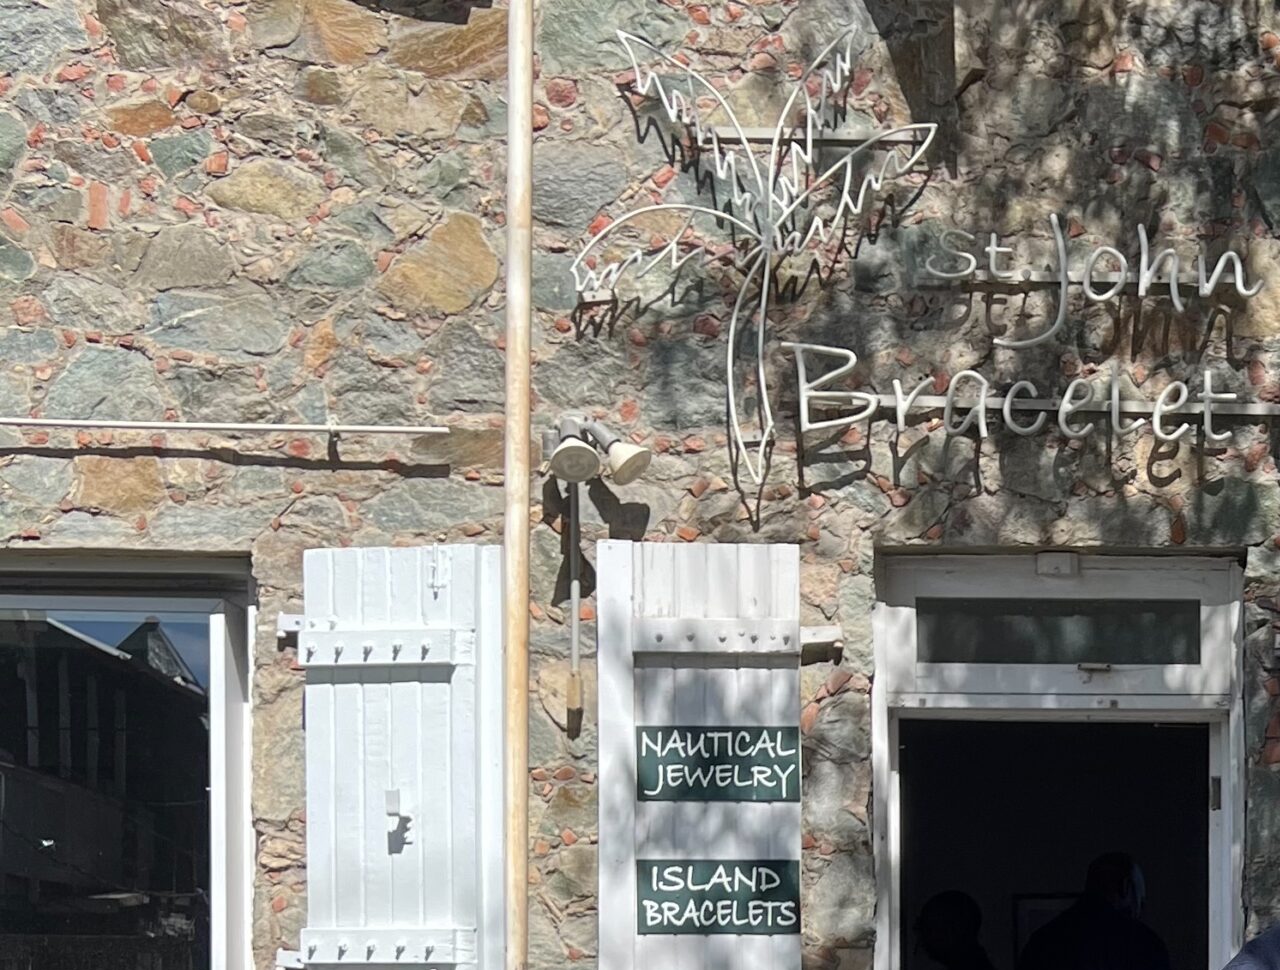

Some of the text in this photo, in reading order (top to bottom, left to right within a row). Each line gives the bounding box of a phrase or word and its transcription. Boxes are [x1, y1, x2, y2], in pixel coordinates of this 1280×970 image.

[993, 212, 1265, 348] John
[780, 341, 1239, 441] Bracelet
[641, 729, 796, 758] NAUTICAL
[643, 763, 797, 799] JEWELRY
[651, 864, 781, 893] ISLAND
[641, 898, 798, 928] BRACELETS
